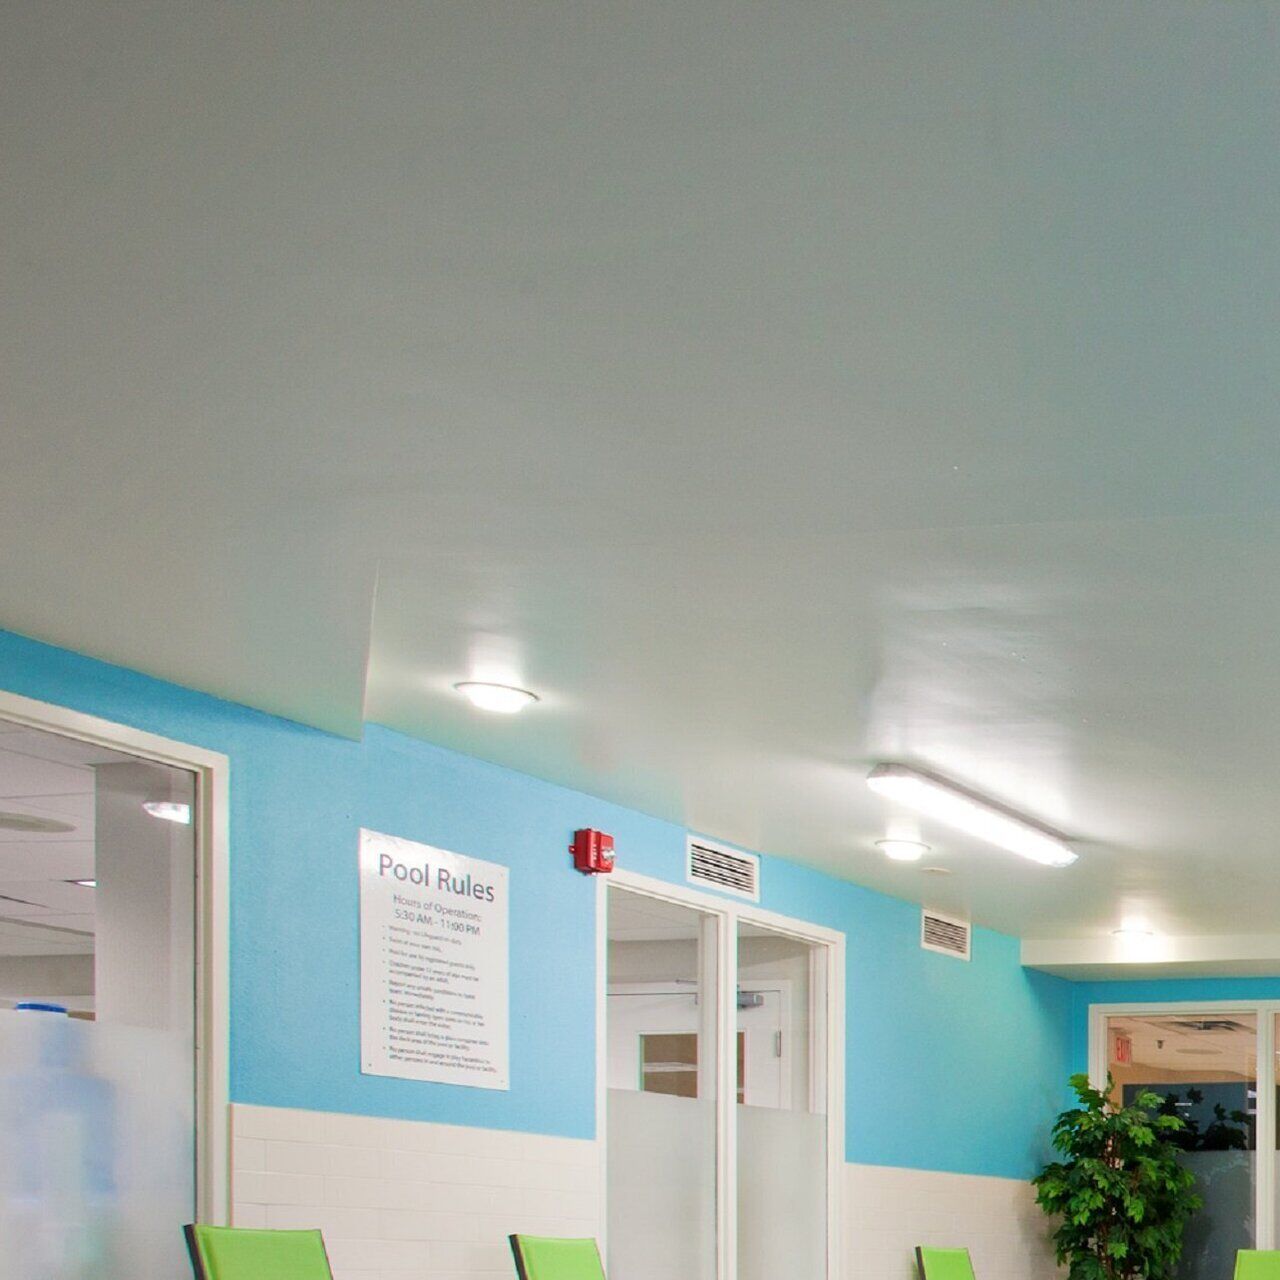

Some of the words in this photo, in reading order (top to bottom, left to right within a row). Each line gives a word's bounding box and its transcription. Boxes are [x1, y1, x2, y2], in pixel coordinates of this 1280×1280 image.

[379, 853, 429, 887] Pool
[437, 868, 495, 902] Rules
[393, 894, 421, 909] Hours
[423, 901, 433, 910] of
[395, 909, 415, 922] 5:30
